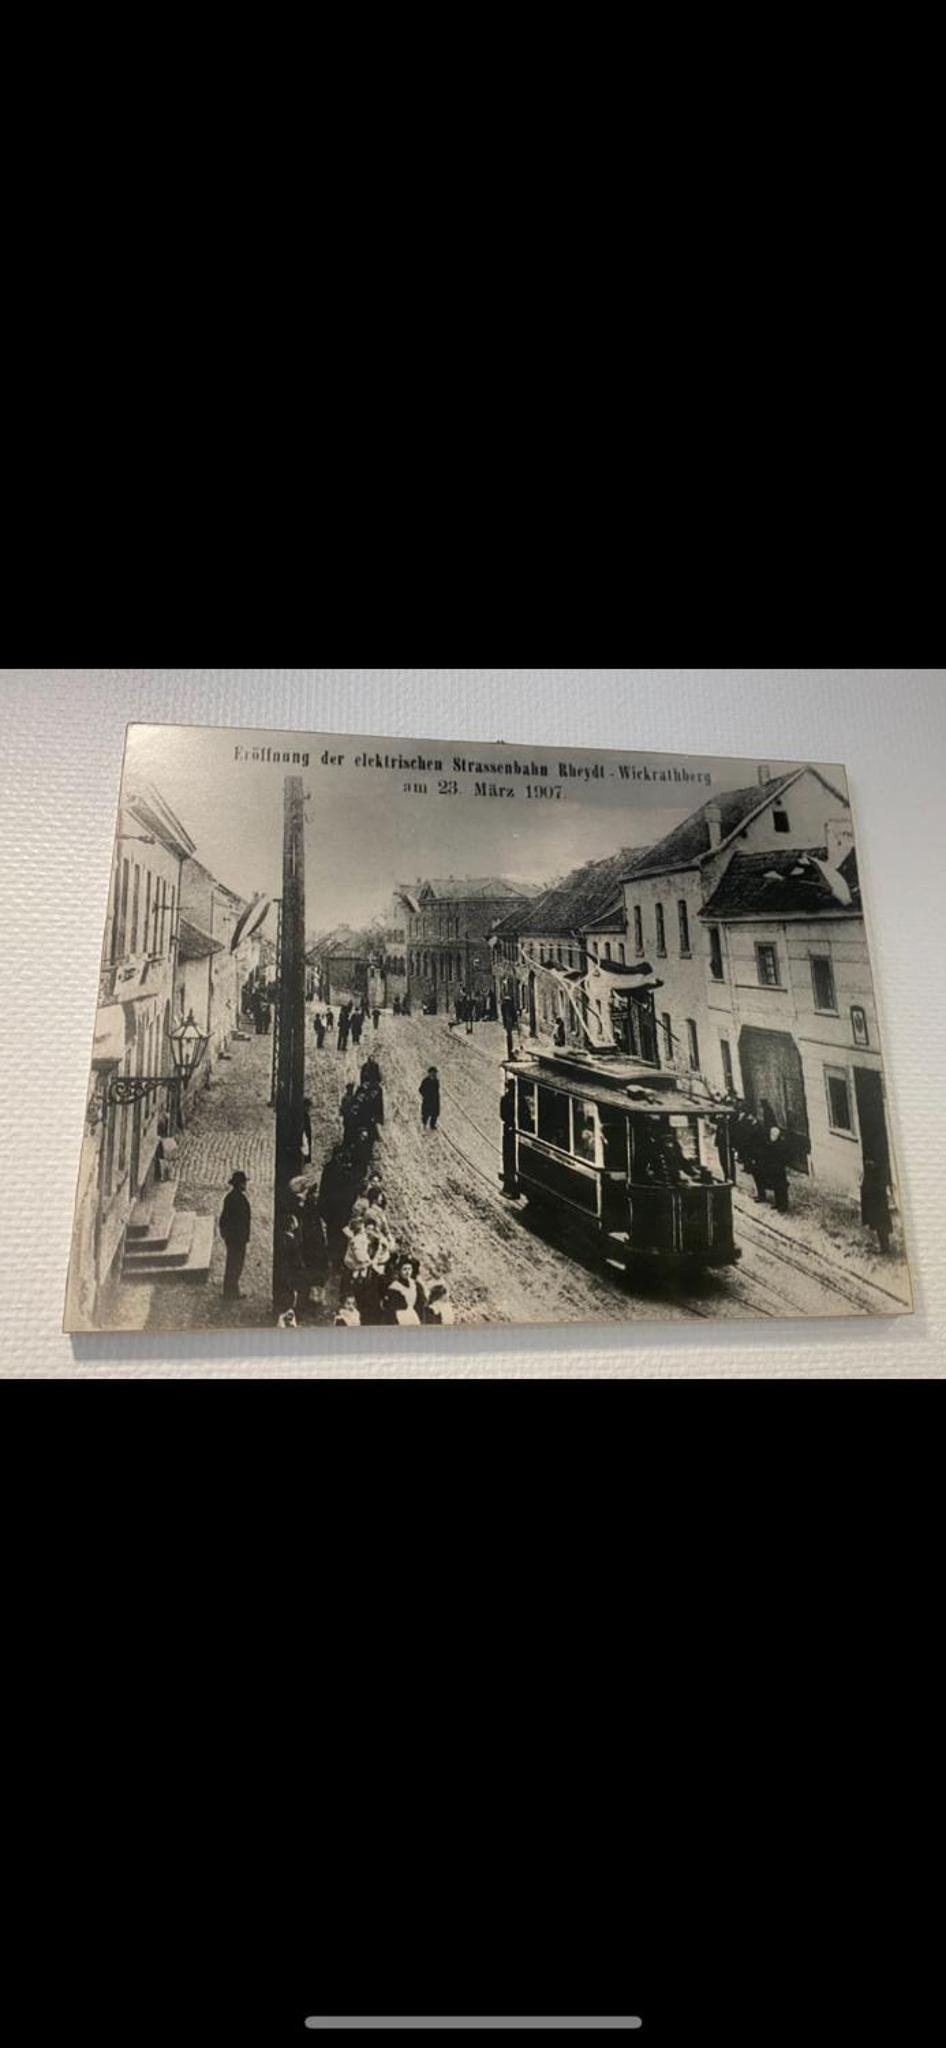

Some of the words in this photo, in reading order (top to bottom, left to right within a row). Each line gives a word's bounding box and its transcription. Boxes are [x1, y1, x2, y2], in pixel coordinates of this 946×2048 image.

[234, 746, 310, 767] Eröffnung
[320, 750, 345, 766] der
[354, 752, 443, 771] elektrischen
[452, 757, 549, 776] Strassenbahn
[558, 762, 605, 782] Rheydt
[619, 766, 711, 786] Wickrathberg
[402, 781, 428, 794] am
[437, 780, 462, 795] 23.
[474, 782, 515, 798] März
